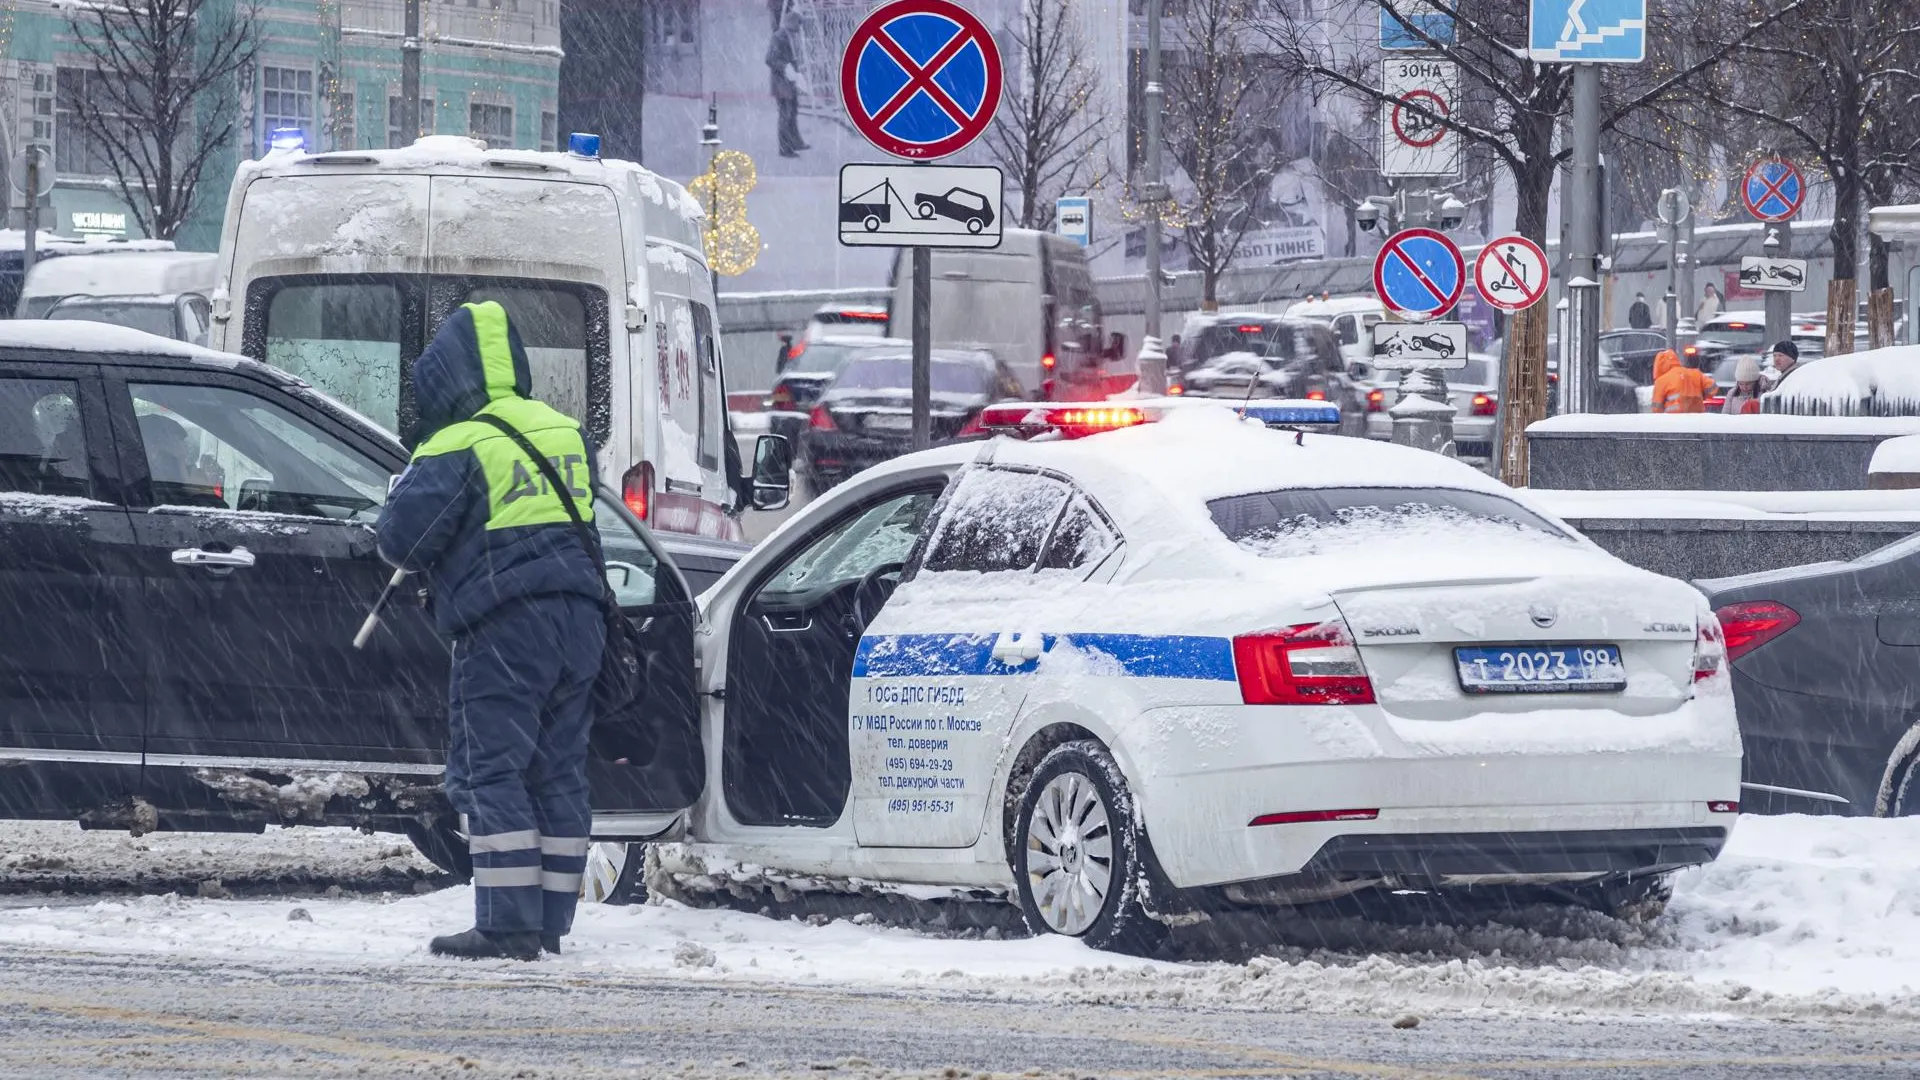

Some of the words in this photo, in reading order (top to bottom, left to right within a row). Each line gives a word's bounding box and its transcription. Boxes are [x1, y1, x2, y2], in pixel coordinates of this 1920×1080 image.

[1399, 64, 1442, 78] ЗОНА
[502, 454, 587, 504] ДПС
[1643, 622, 1691, 632] CTAVIA
[1500, 651, 1570, 681] 2023
[1583, 649, 1610, 674] 99
[867, 686, 873, 703] 1
[875, 687, 899, 703] ОСБ
[901, 686, 924, 705] ДПС
[927, 686, 965, 706] ГИБДД
[852, 715, 864, 731] ГУ
[866, 715, 888, 732] МВД
[889, 715, 923, 730] России
[925, 718, 936, 730] по
[939, 718, 945, 731] г.
[887, 738, 906, 749] тел.
[908, 738, 949, 753] доверия
[885, 757, 907, 771] (495)
[909, 757, 953, 771] 694-29-29
[878, 776, 896, 788] тел.
[896, 776, 939, 791] дежурной
[940, 778, 965, 789] части
[888, 799, 910, 813] (495)
[911, 799, 954, 813] 951-55-31
